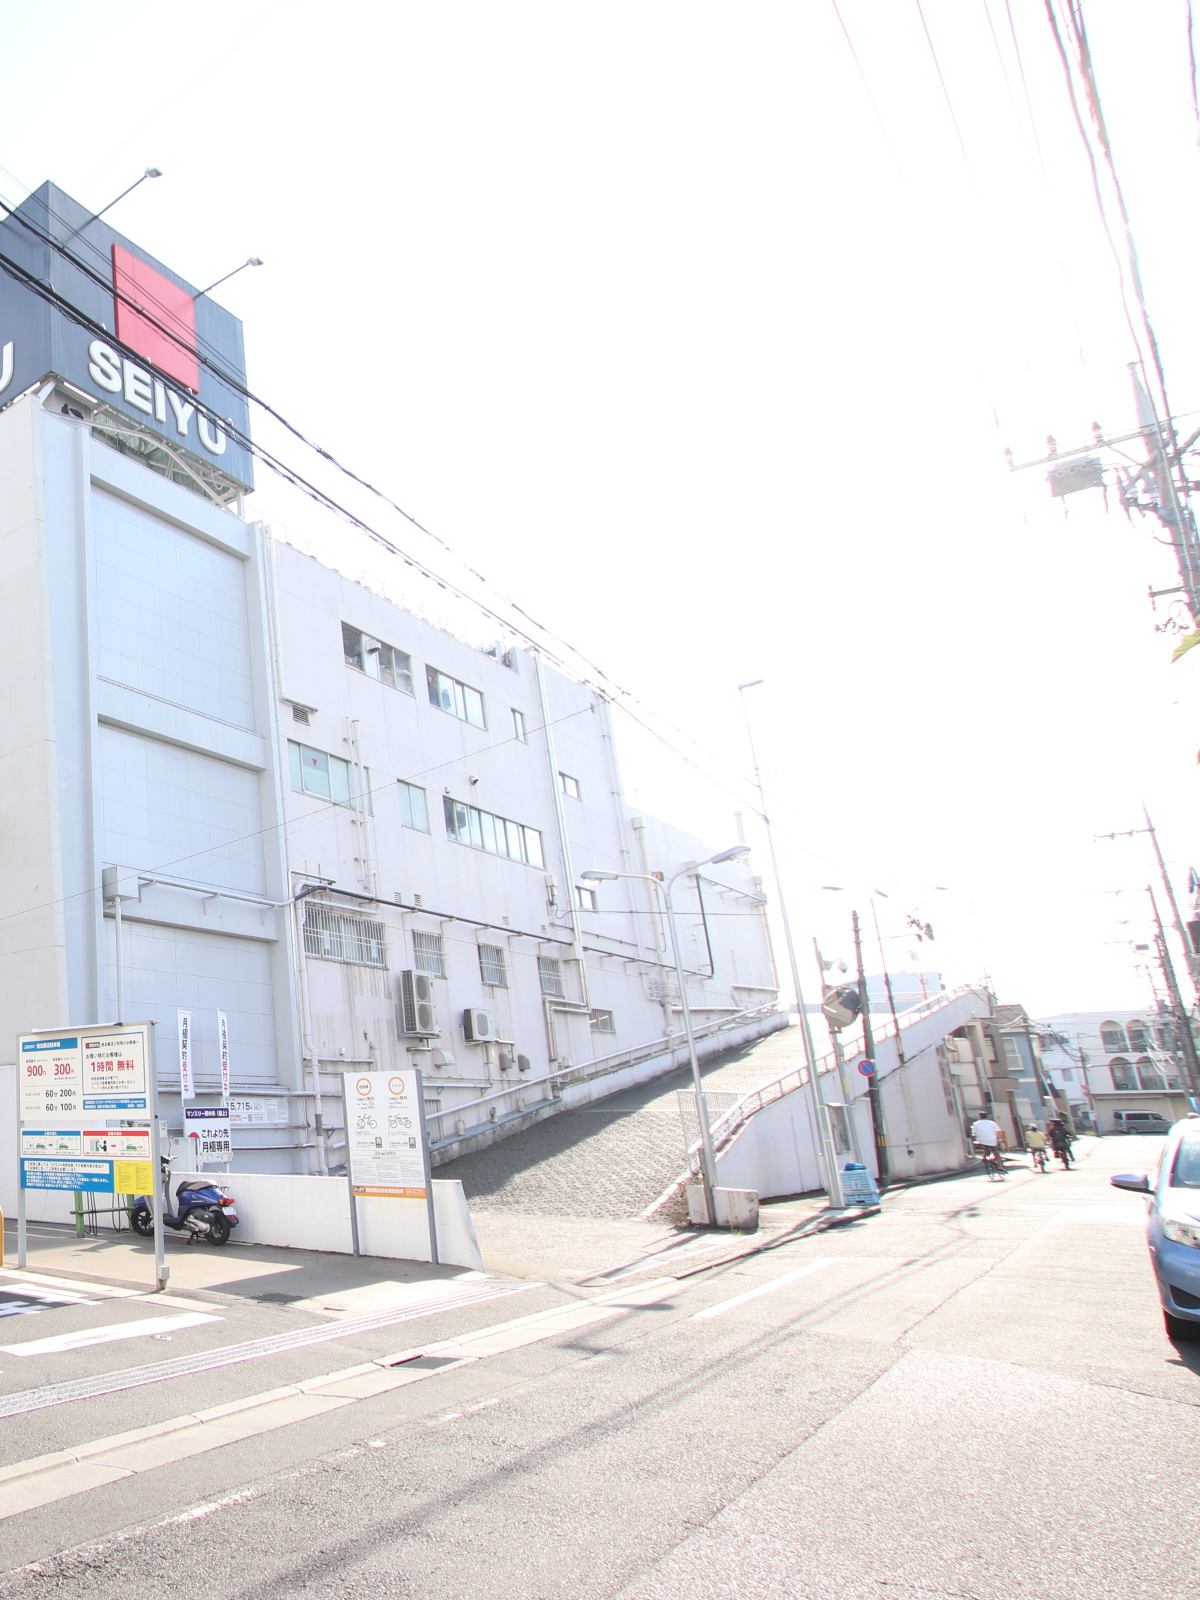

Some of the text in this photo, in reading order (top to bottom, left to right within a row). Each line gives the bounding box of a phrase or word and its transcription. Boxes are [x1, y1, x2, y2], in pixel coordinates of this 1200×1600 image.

[88, 339, 235, 456] SEIYU
[91, 1059, 134, 1072] 1時間 無料
[60, 1089, 76, 1097] 200円
[60, 1103, 76, 1111] 100円
[201, 1129, 230, 1138] これより先
[202, 1141, 230, 1152] 月極専用
